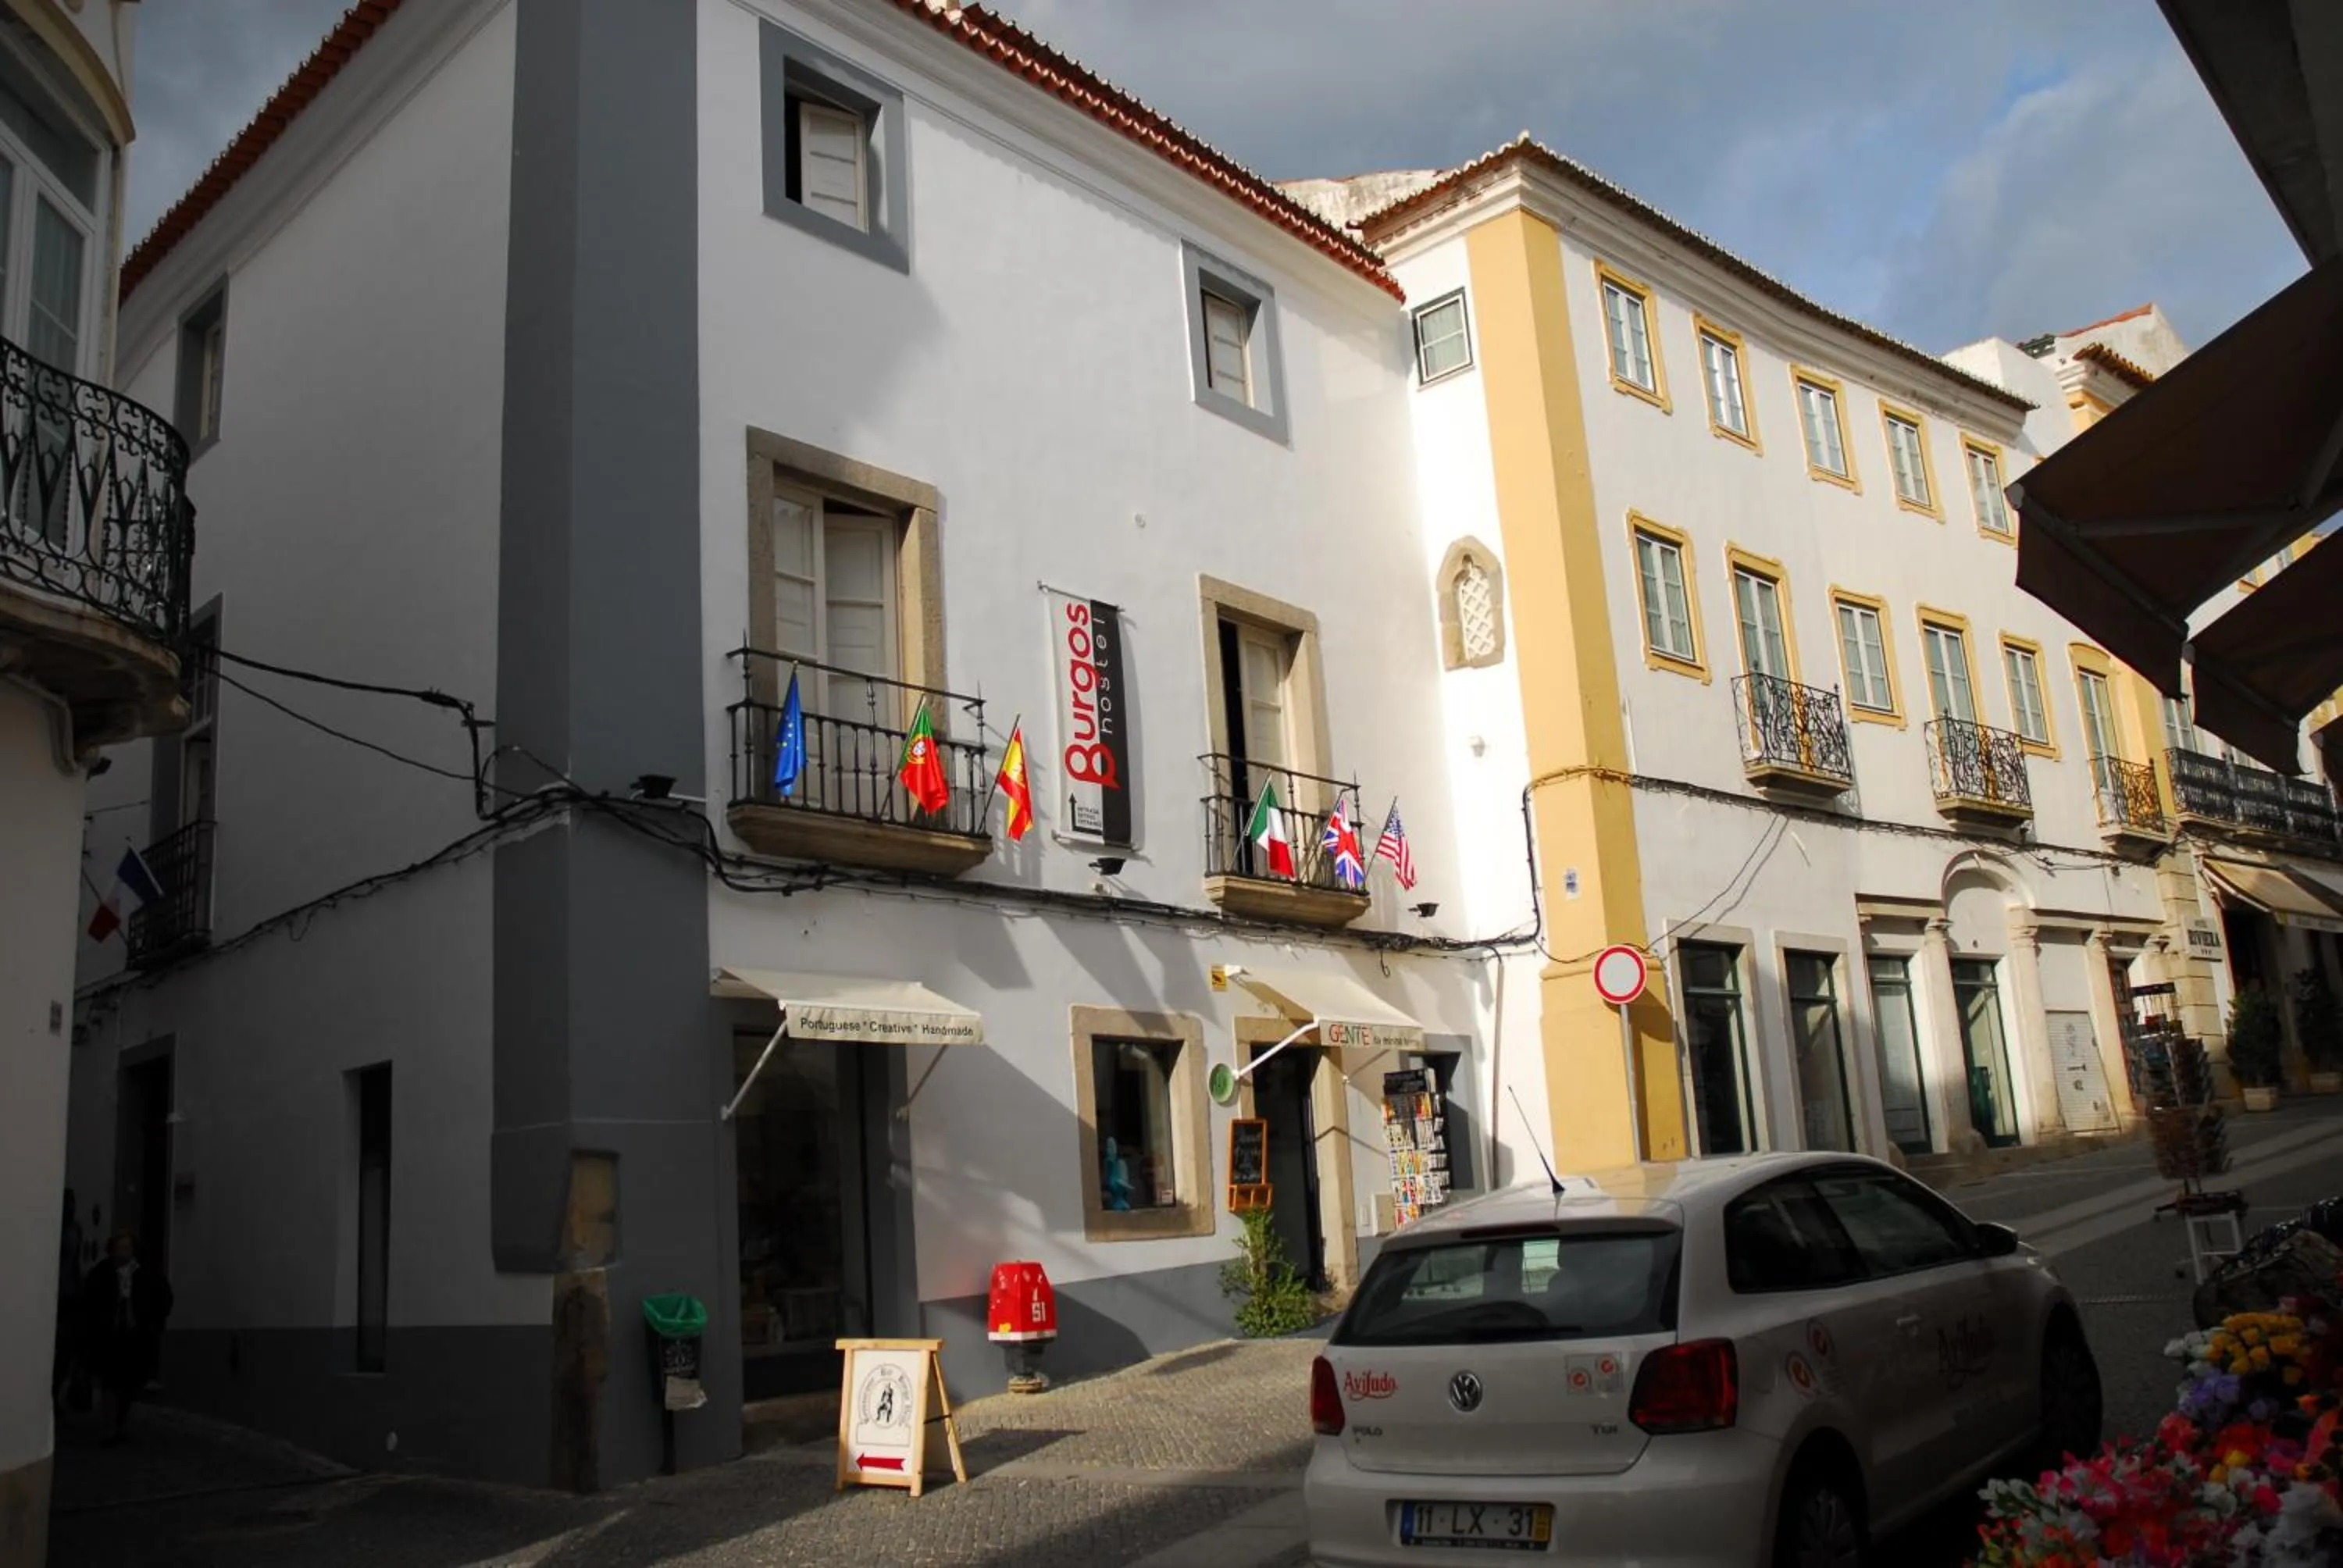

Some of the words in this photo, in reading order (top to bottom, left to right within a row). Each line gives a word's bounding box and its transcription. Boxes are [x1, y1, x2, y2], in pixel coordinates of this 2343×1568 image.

[1065, 603, 1121, 791] Burgos
[1093, 617, 1113, 735] hostel
[801, 1017, 861, 1033] Portuguese
[922, 1024, 974, 1036] Handmade
[1328, 1024, 1371, 1046] GENTE
